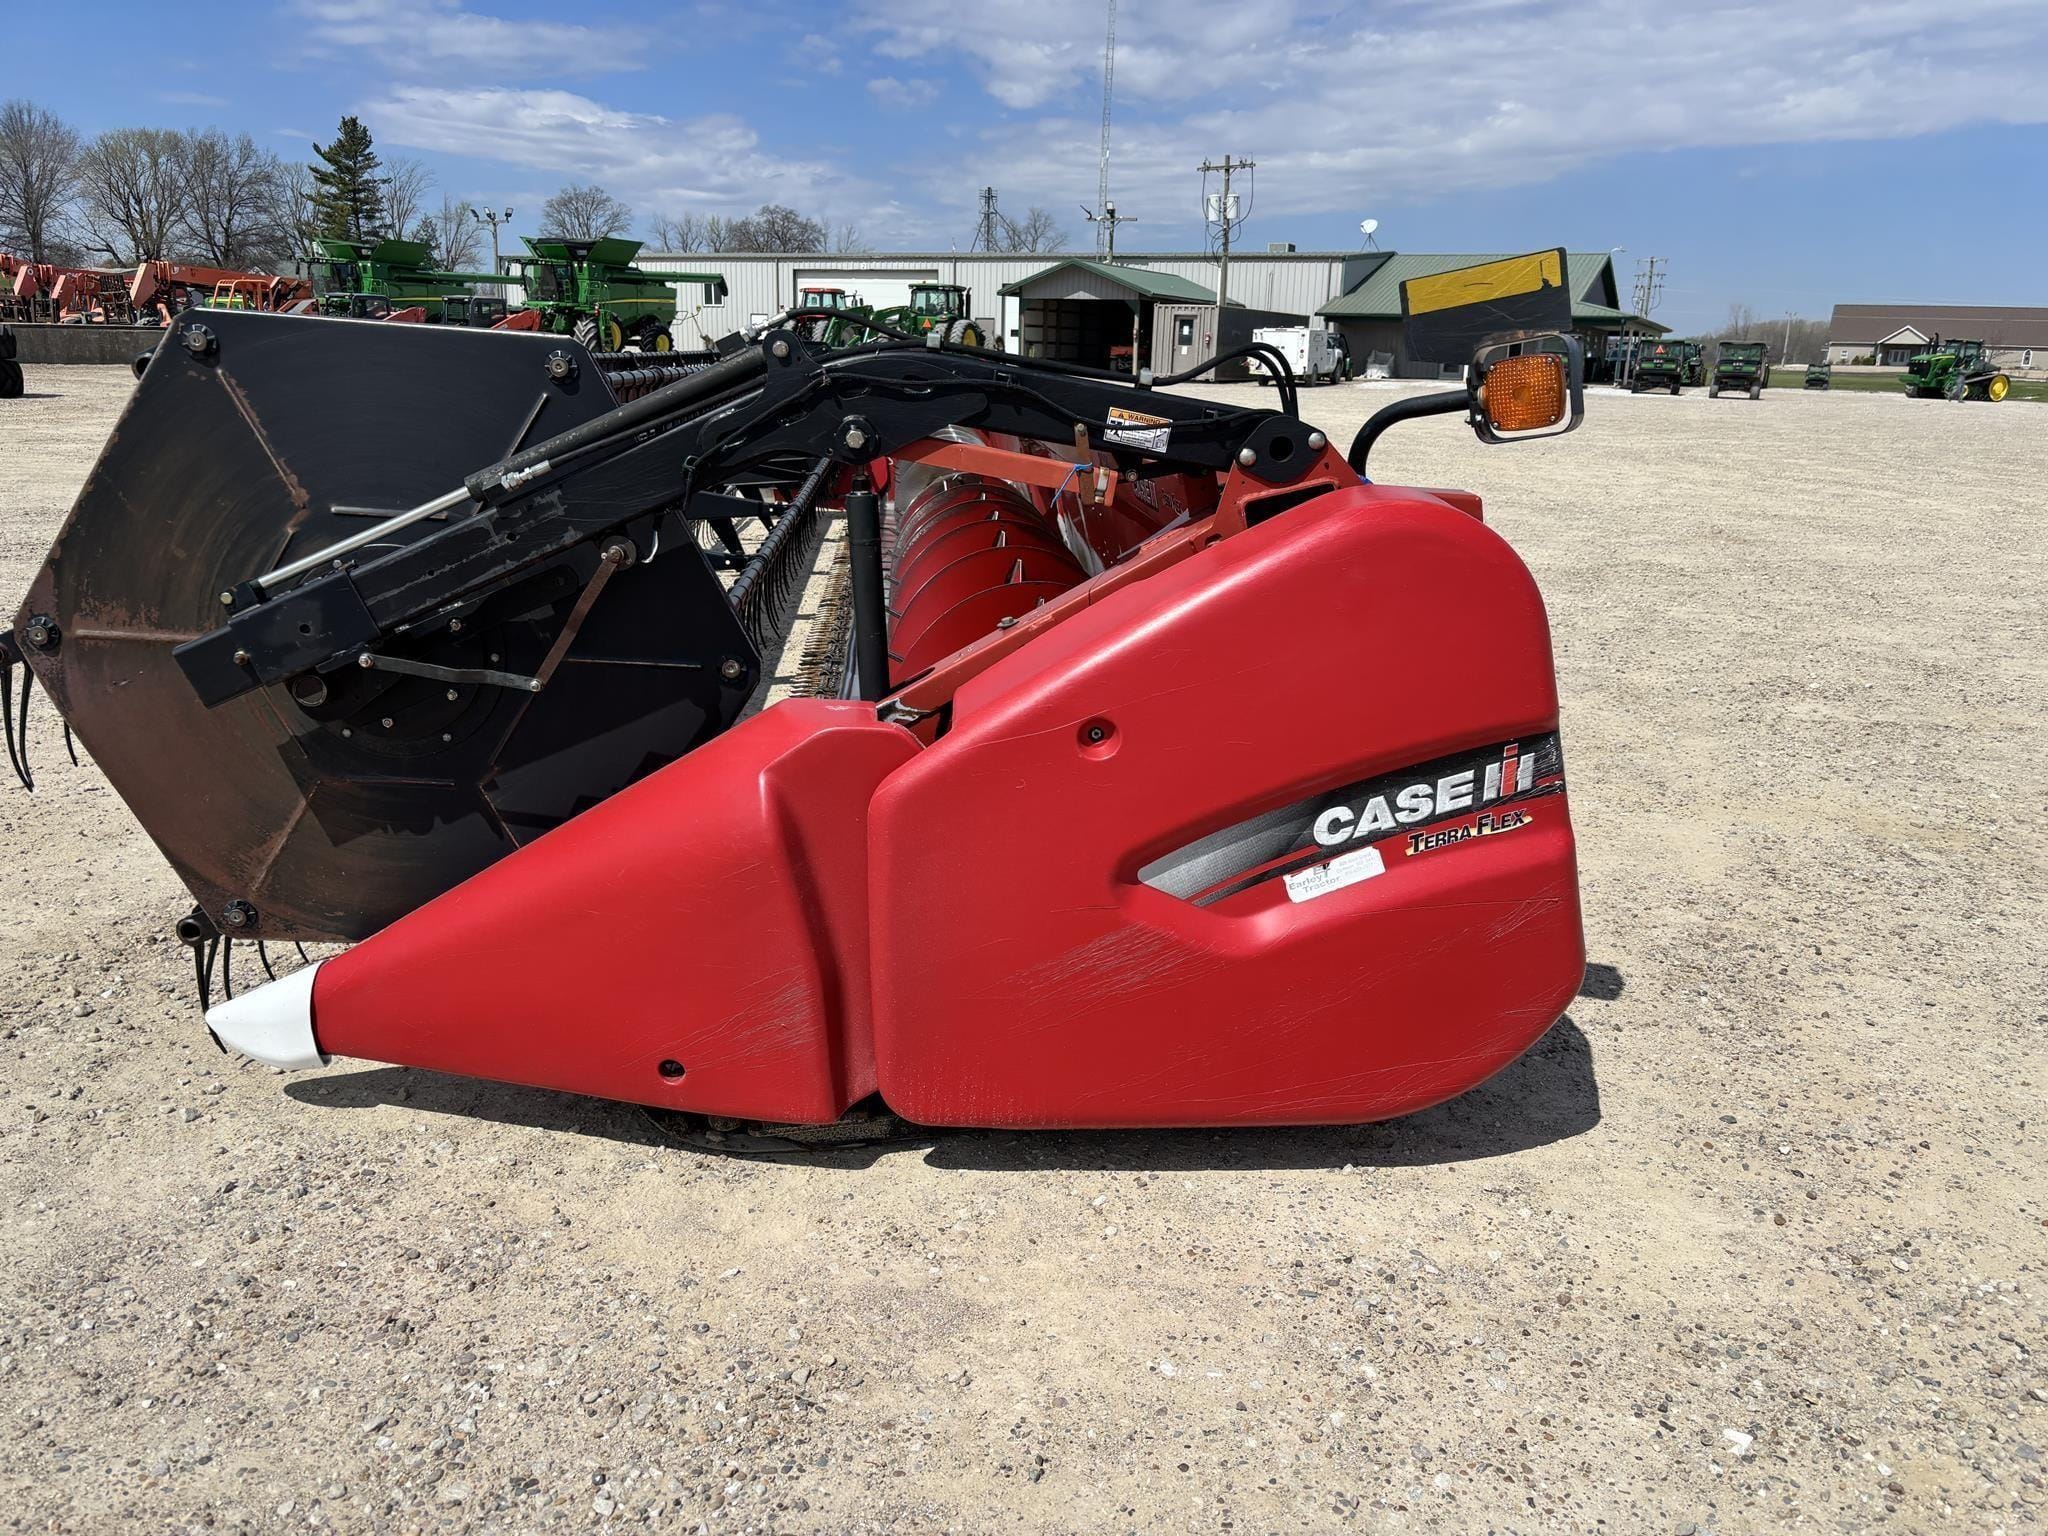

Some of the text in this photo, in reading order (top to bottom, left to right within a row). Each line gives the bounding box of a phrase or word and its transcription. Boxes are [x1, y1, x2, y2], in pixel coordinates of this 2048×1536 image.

[1128, 413, 1161, 425] WARNING
[1313, 769, 1475, 846] CASE
[1288, 873, 1322, 890] Earley
[1303, 876, 1341, 893] Tractor
